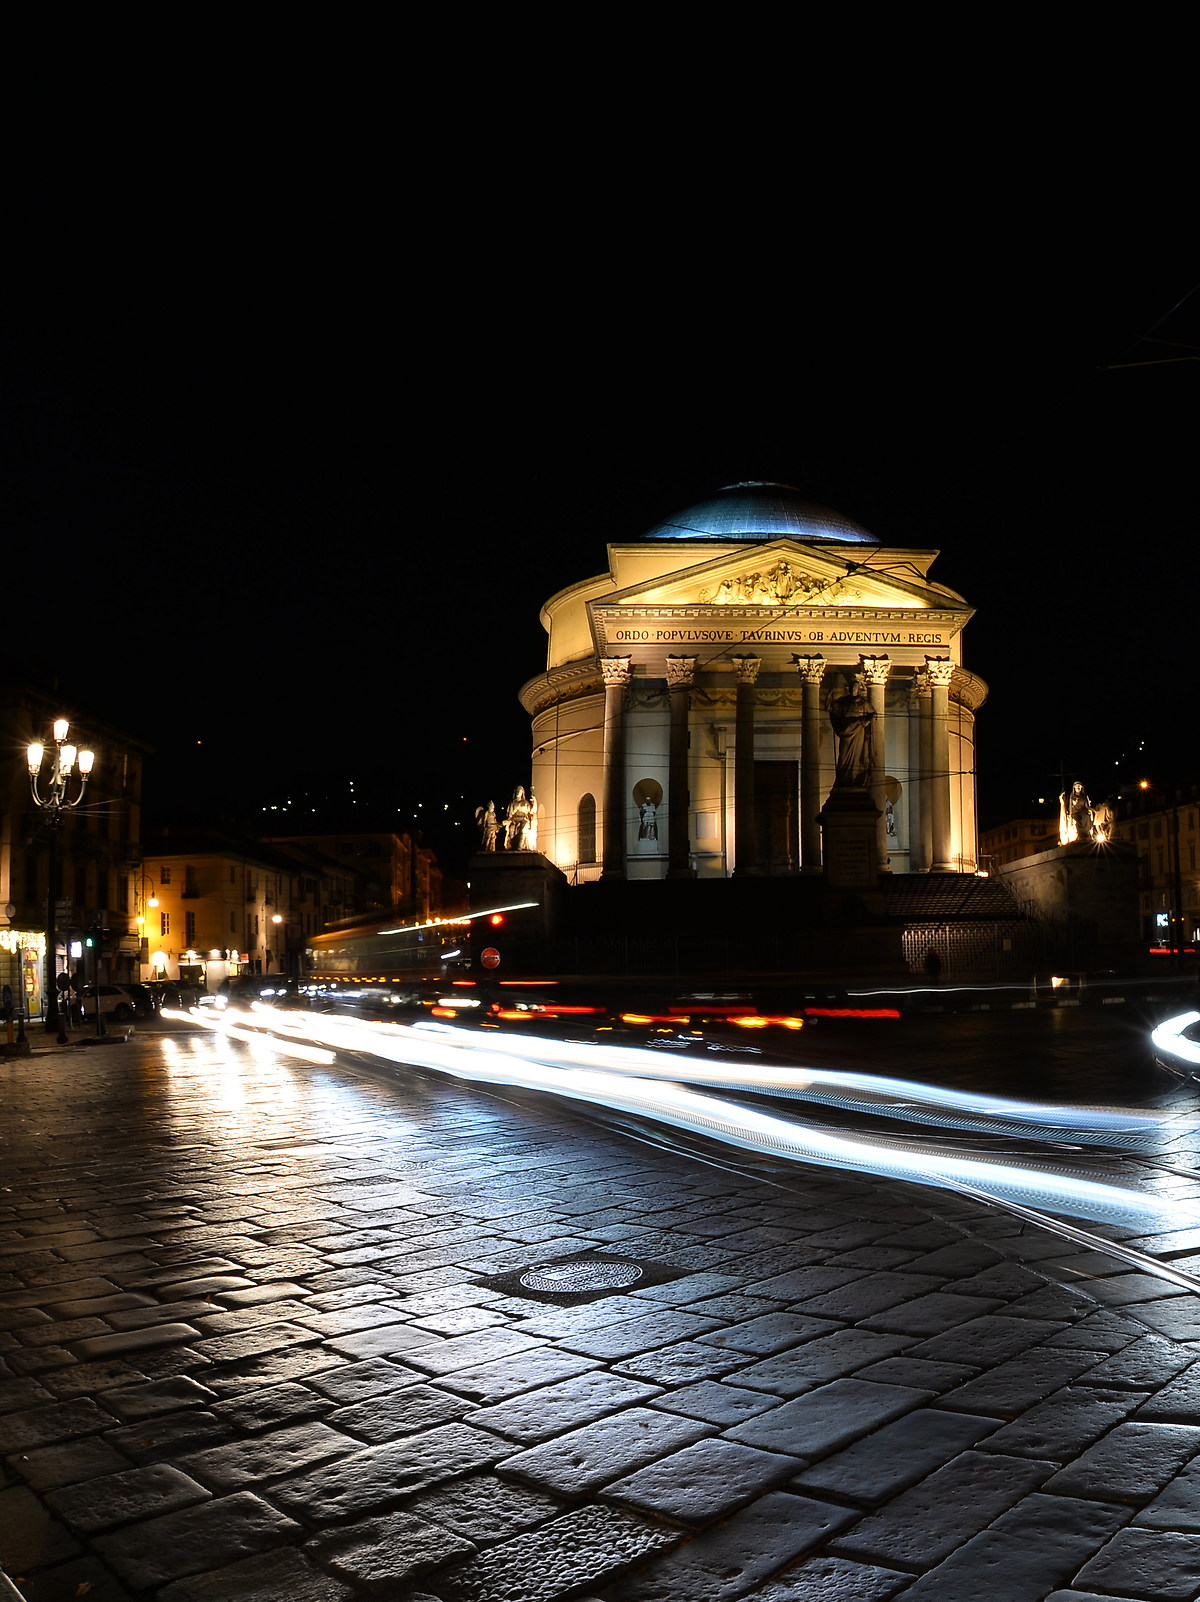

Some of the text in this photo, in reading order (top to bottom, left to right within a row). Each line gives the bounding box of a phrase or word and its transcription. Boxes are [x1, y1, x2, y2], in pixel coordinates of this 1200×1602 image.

[616, 630, 942, 643] ORDO POPVLVSQVE TAVRINVS OB ADVENTVM REGIS
